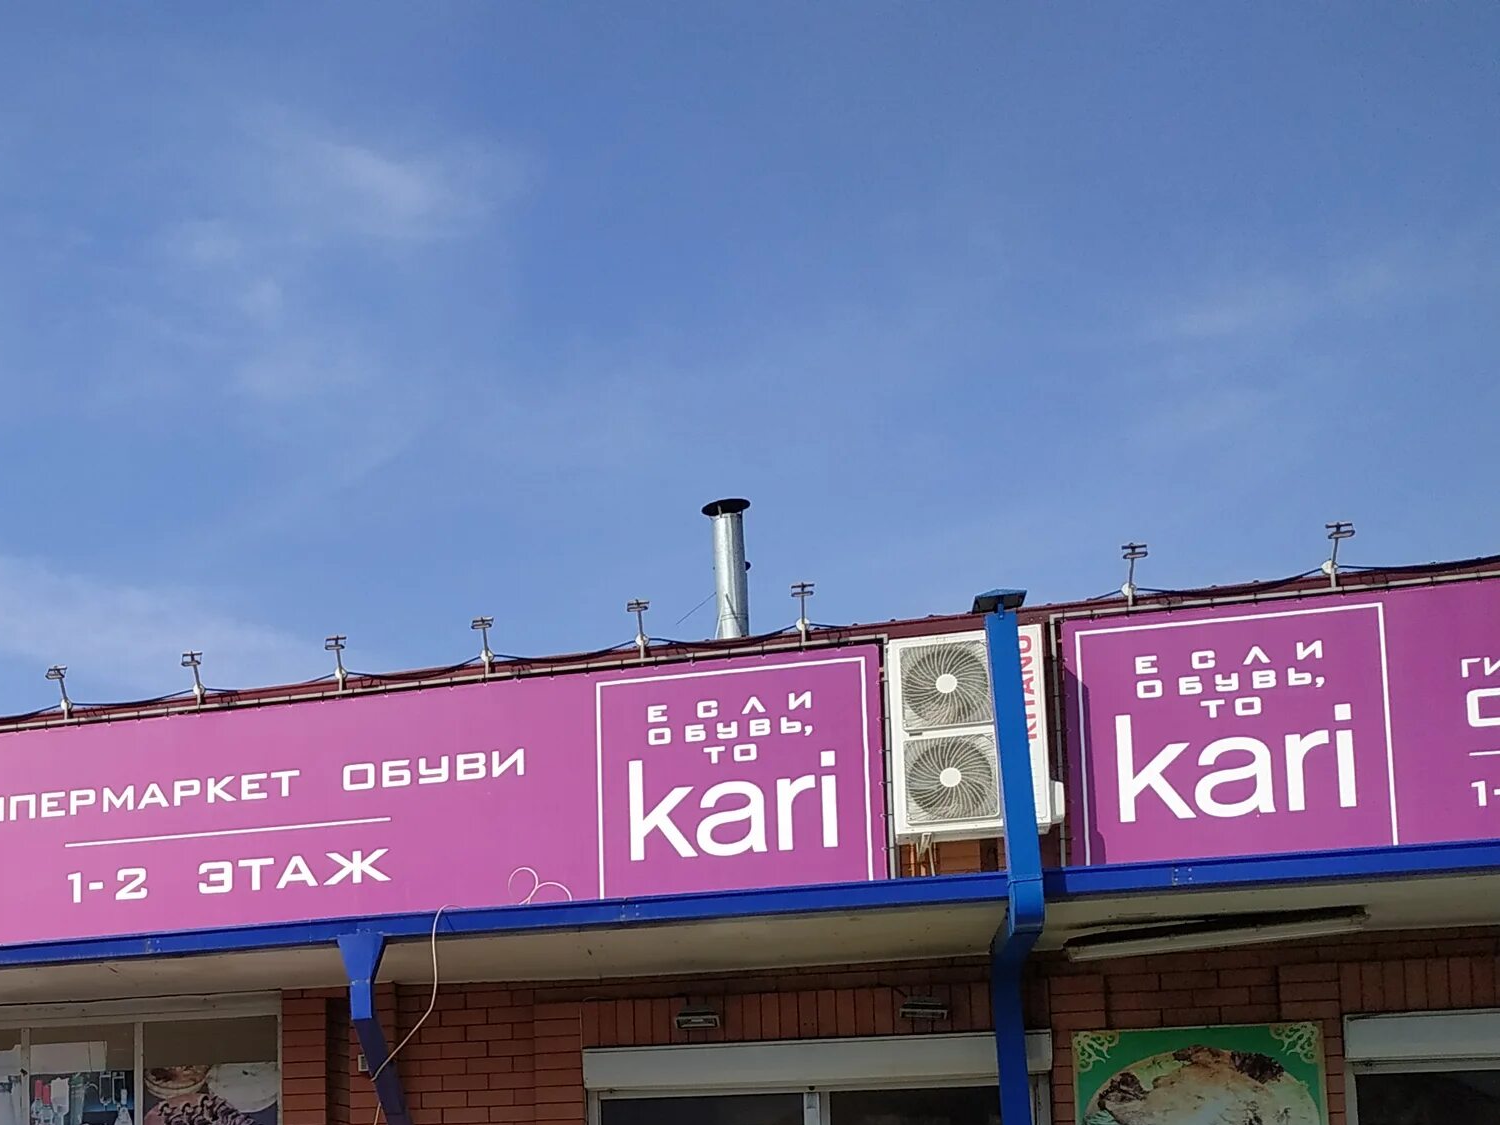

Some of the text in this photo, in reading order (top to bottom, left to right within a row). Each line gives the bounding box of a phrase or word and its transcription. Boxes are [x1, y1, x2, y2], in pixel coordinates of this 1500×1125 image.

[1135, 641, 1323, 675] ЕСЛИ
[1135, 667, 1325, 700] ОБУВЬ,
[647, 691, 812, 723] ЕСЛИ
[1199, 696, 1262, 718] ТО
[647, 717, 814, 745] ОБУВЬ,
[341, 749, 525, 791] ОБУВИ
[703, 743, 757, 764] ТО
[1114, 704, 1358, 823] kari
[628, 750, 839, 861] kari
[66, 848, 391, 904] 1-2 ЭТАЖ
